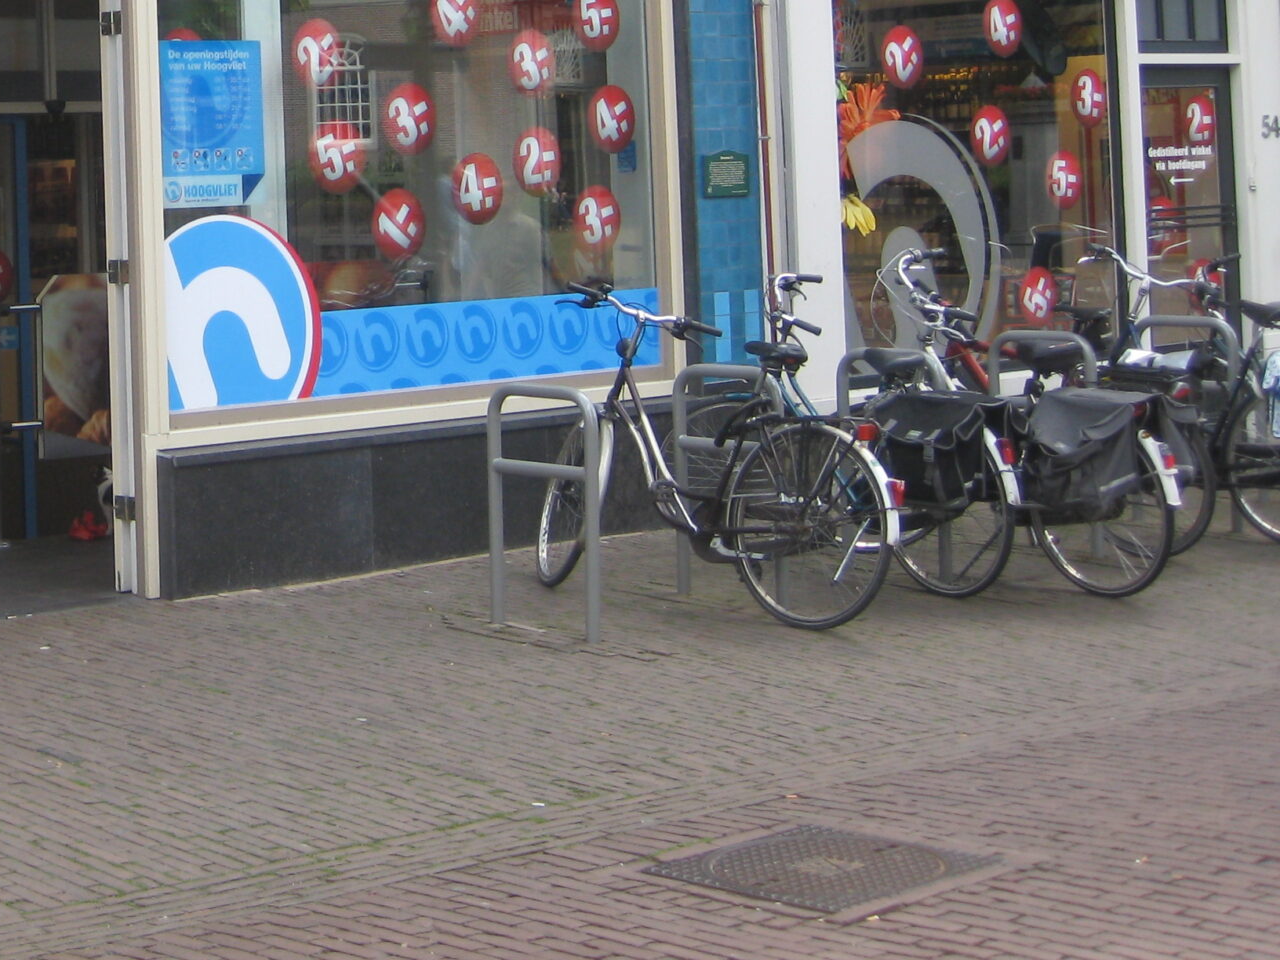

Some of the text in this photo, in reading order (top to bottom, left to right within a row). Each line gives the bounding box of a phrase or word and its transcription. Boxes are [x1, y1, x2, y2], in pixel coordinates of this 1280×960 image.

[168, 49, 250, 61] De openingstijden
[168, 61, 247, 73] van uw Hoogvliet
[1190, 145, 1212, 156] winkel
[1155, 159, 1206, 171] via hoofdingang
[184, 183, 238, 198] HOOGVLIET
